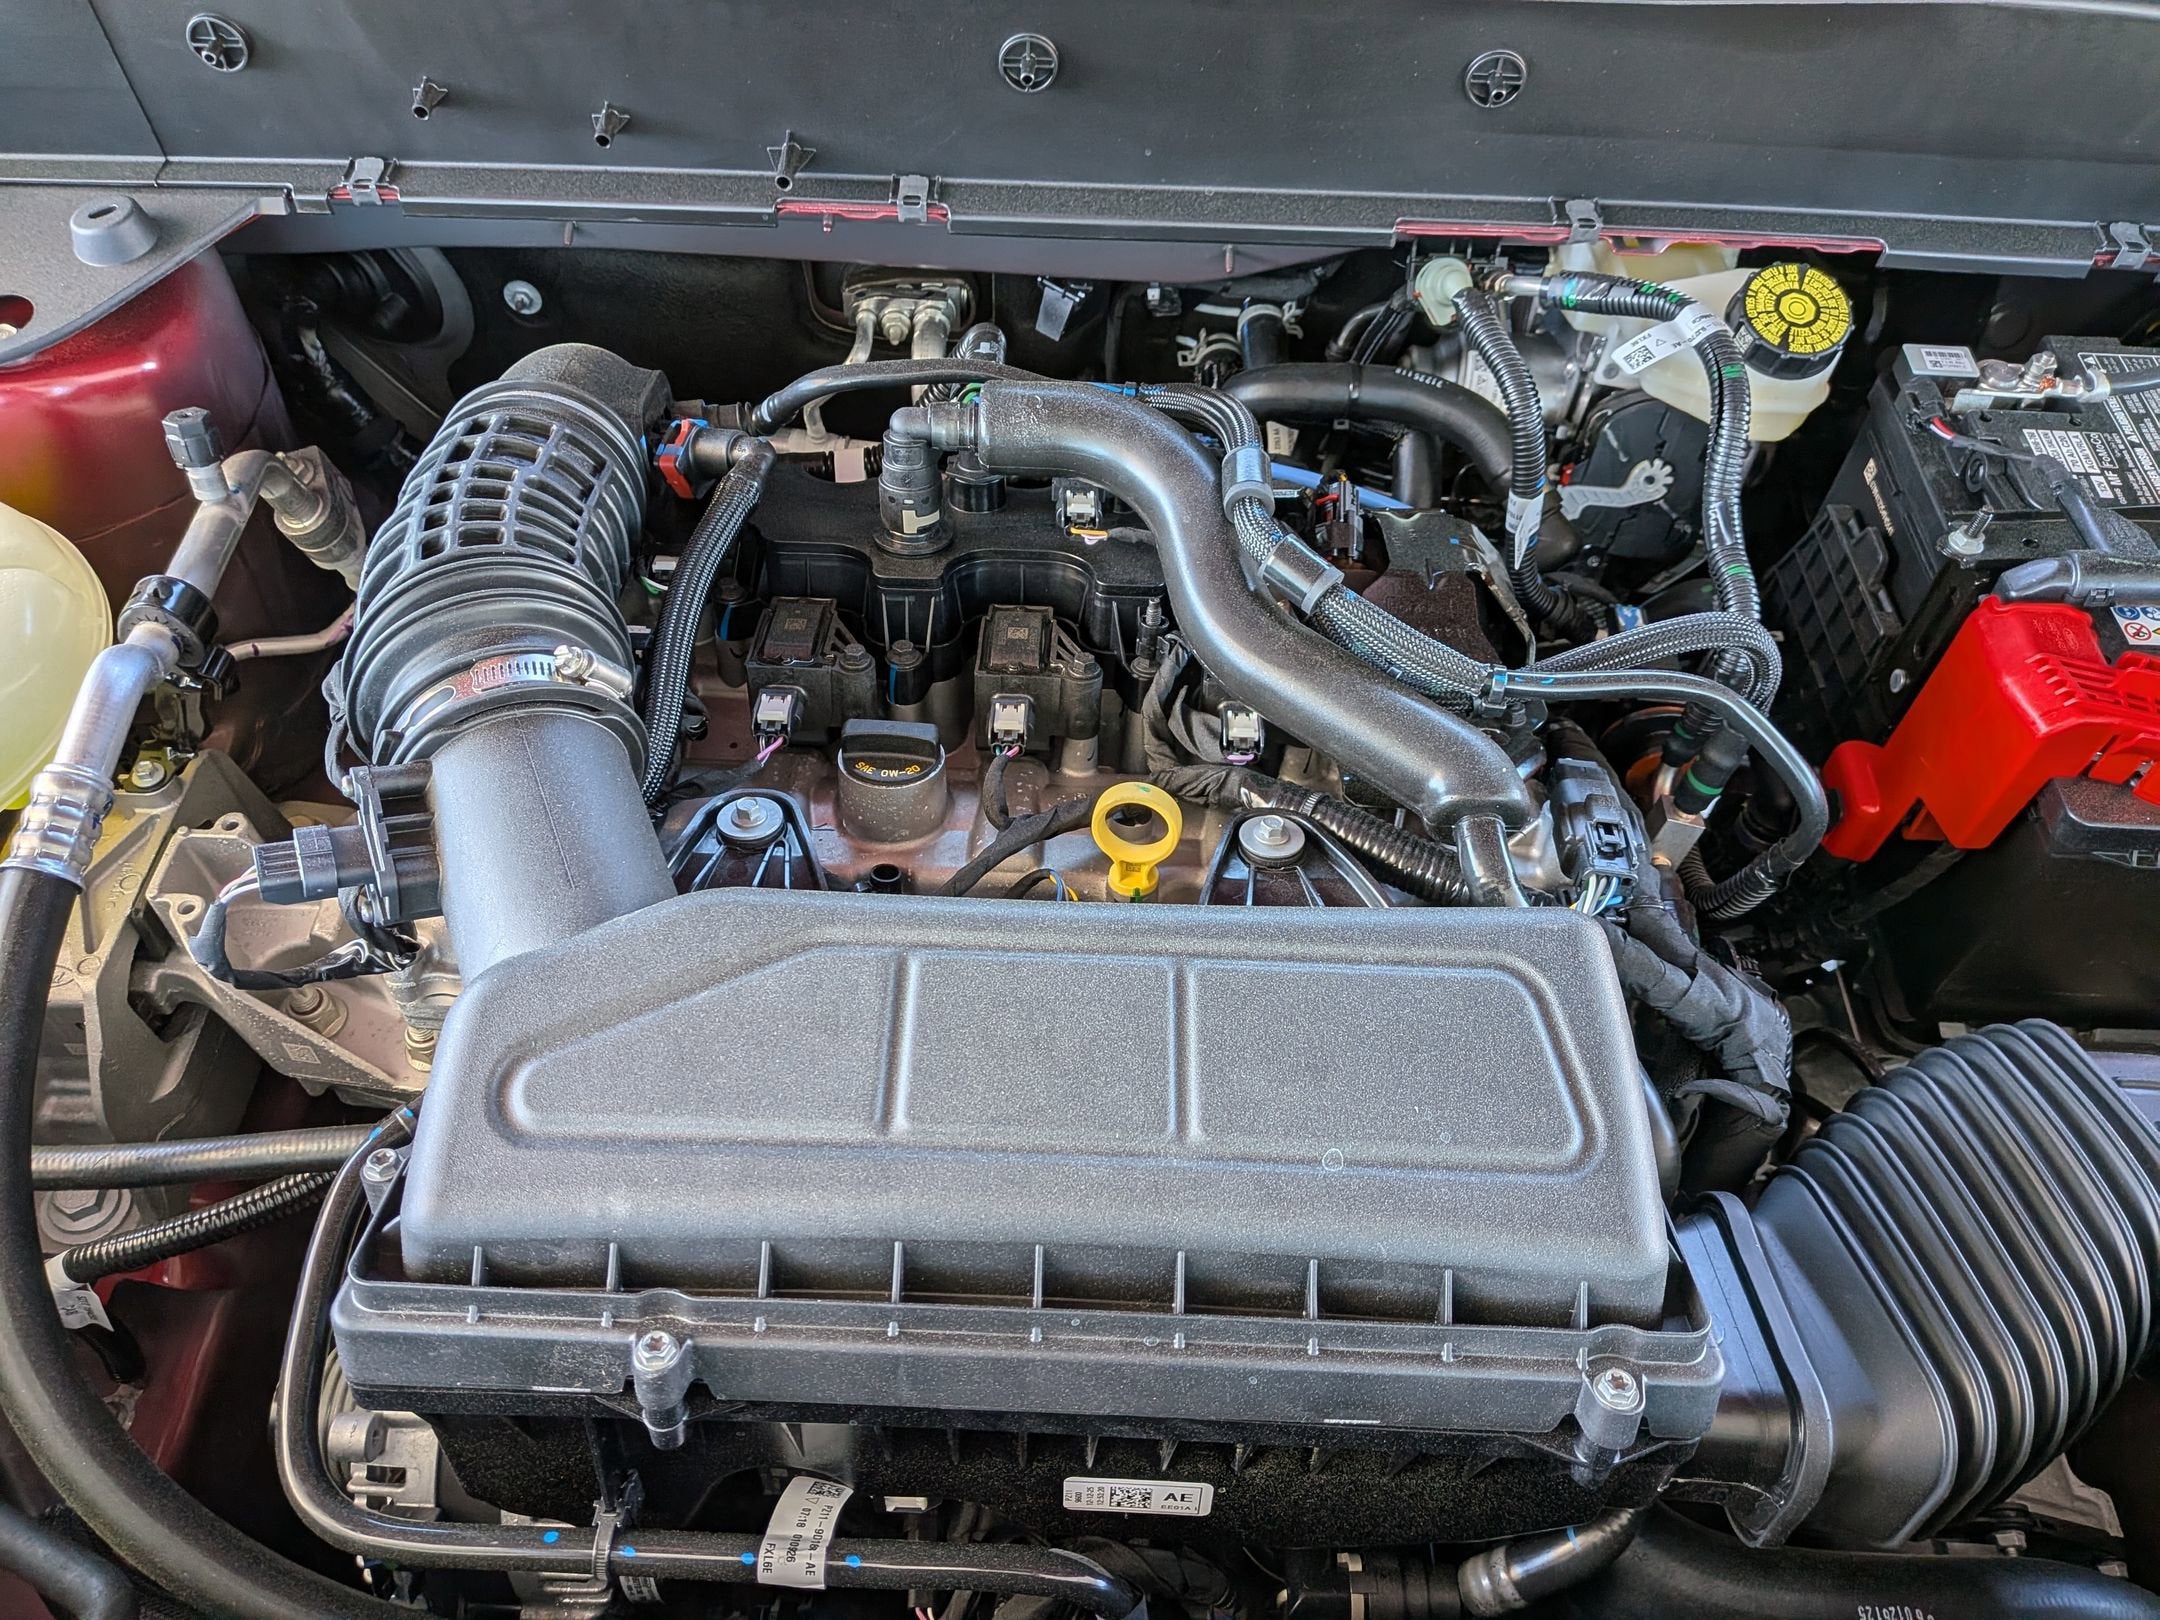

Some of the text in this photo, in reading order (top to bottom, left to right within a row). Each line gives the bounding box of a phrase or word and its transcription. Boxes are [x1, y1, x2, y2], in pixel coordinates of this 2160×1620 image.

[2090, 433, 2113, 468] FoMoCo
[855, 761, 877, 775] SAE
[1065, 1489, 1073, 1502] PZ11
[1163, 1492, 1194, 1503] AE
[796, 1507, 812, 1528] 07:18
[762, 1542, 776, 1574] FXL6E
